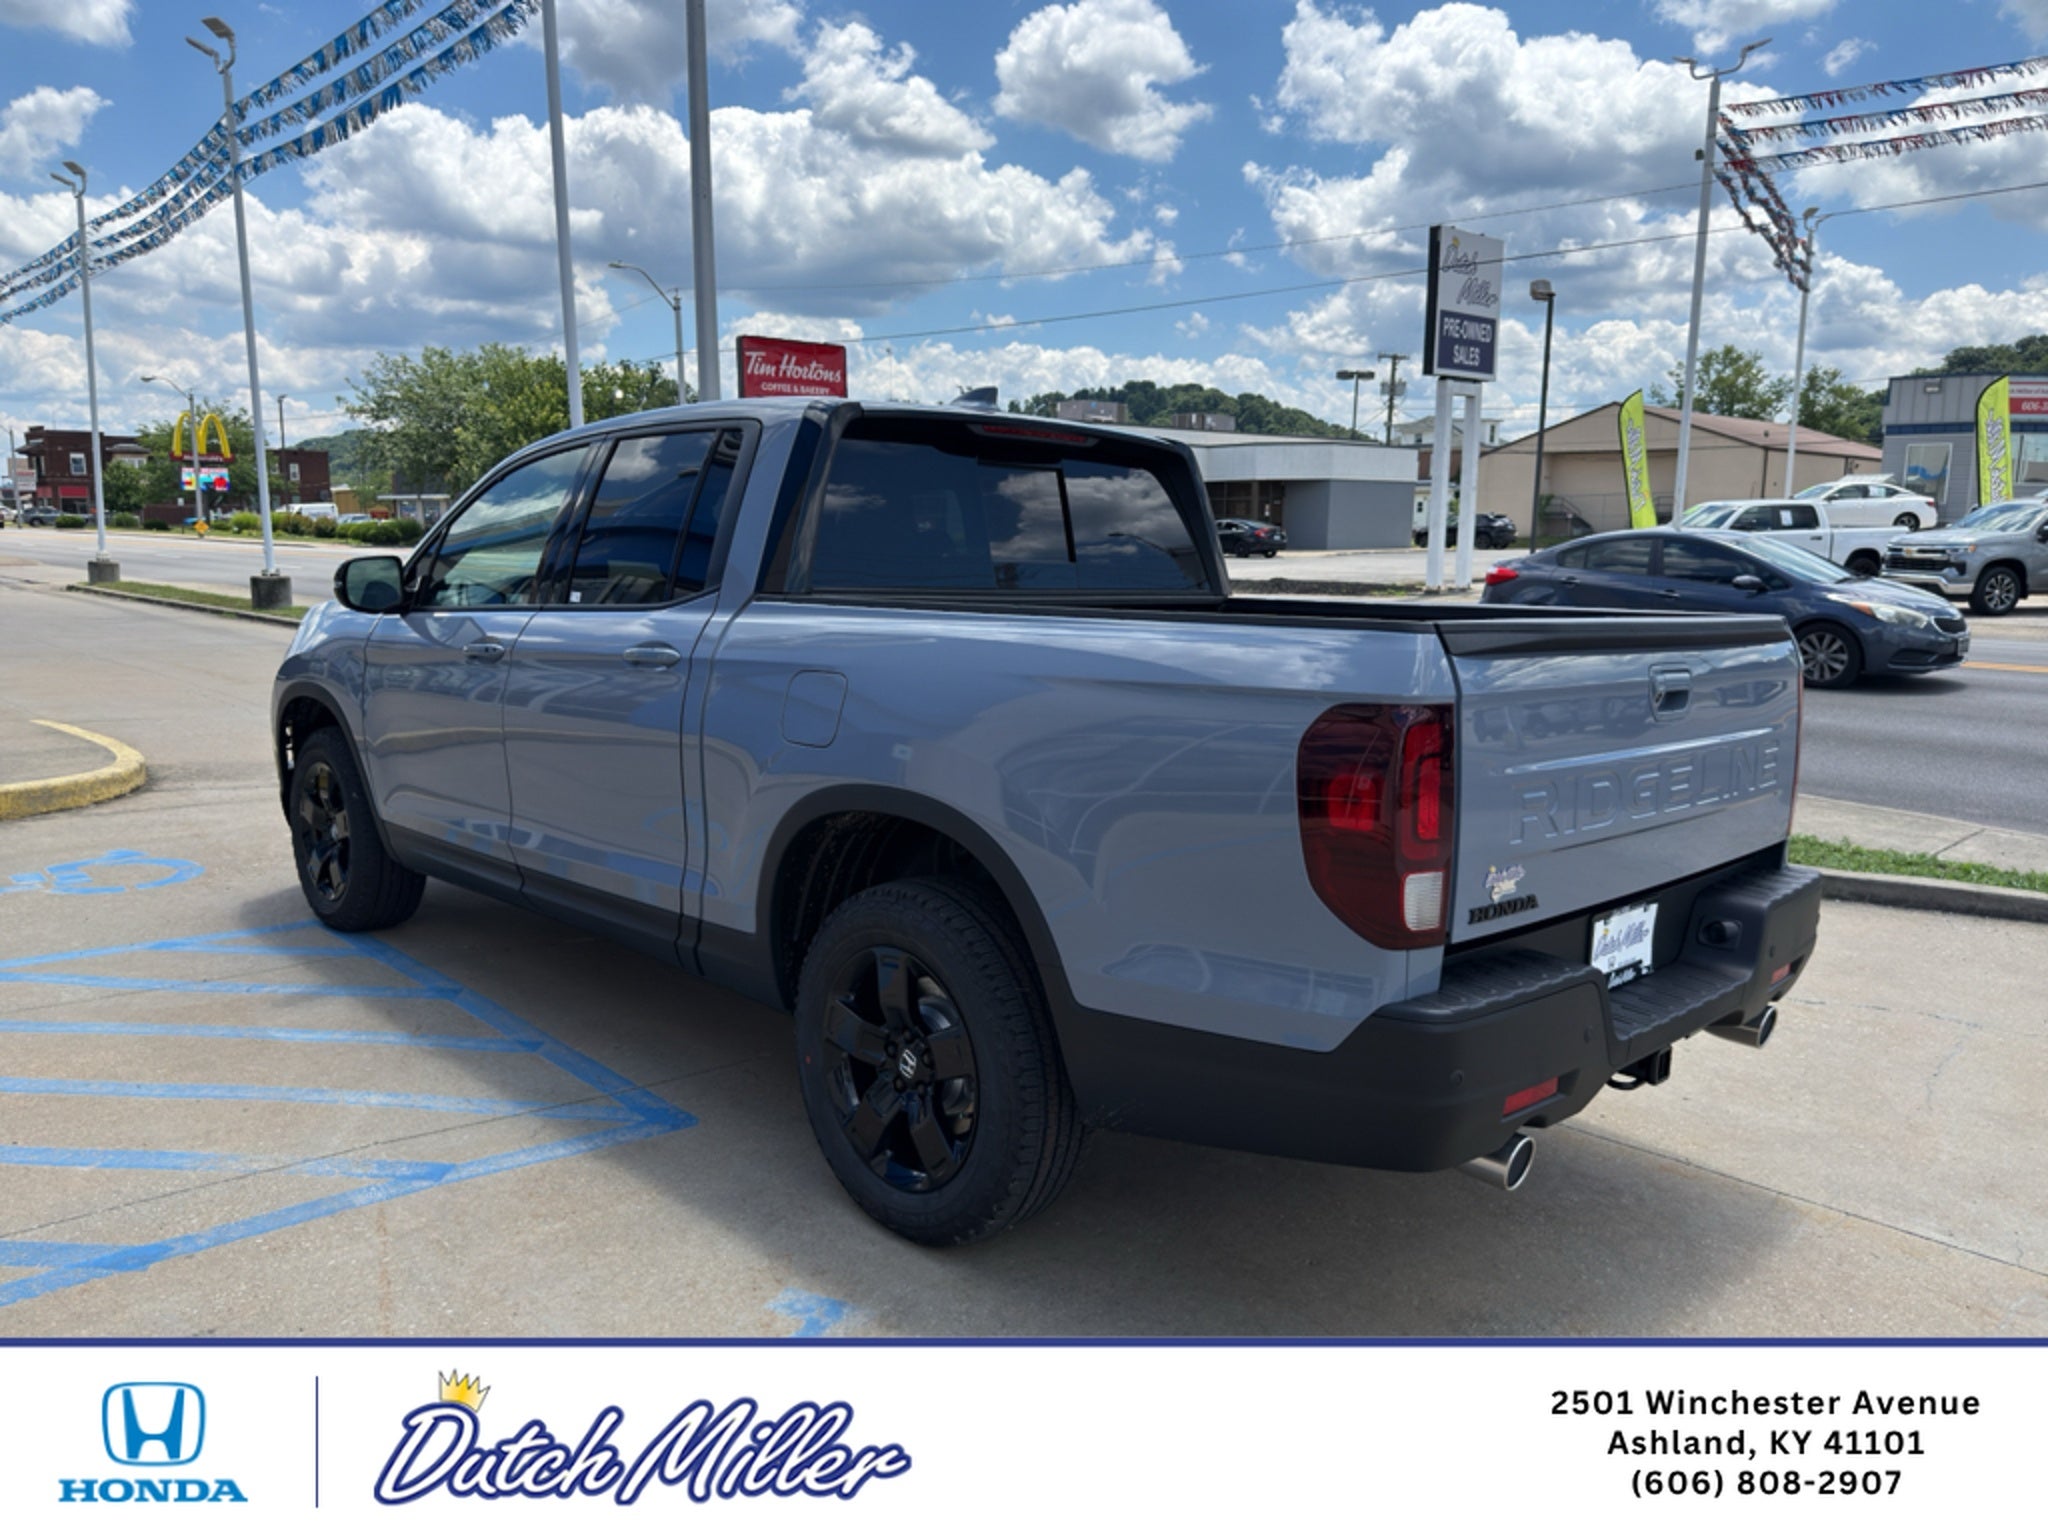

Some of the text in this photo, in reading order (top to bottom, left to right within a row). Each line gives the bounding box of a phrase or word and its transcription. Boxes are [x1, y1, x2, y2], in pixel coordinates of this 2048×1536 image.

[1442, 316, 1493, 343] PRE-OWNED
[744, 351, 842, 383] Tim Hortons
[1453, 344, 1480, 367] SALES
[761, 382, 792, 393] COFFEE
[799, 385, 831, 395] BAKERY
[1508, 739, 1780, 845] RIDGELINE
[1468, 894, 1539, 925] HONDA
